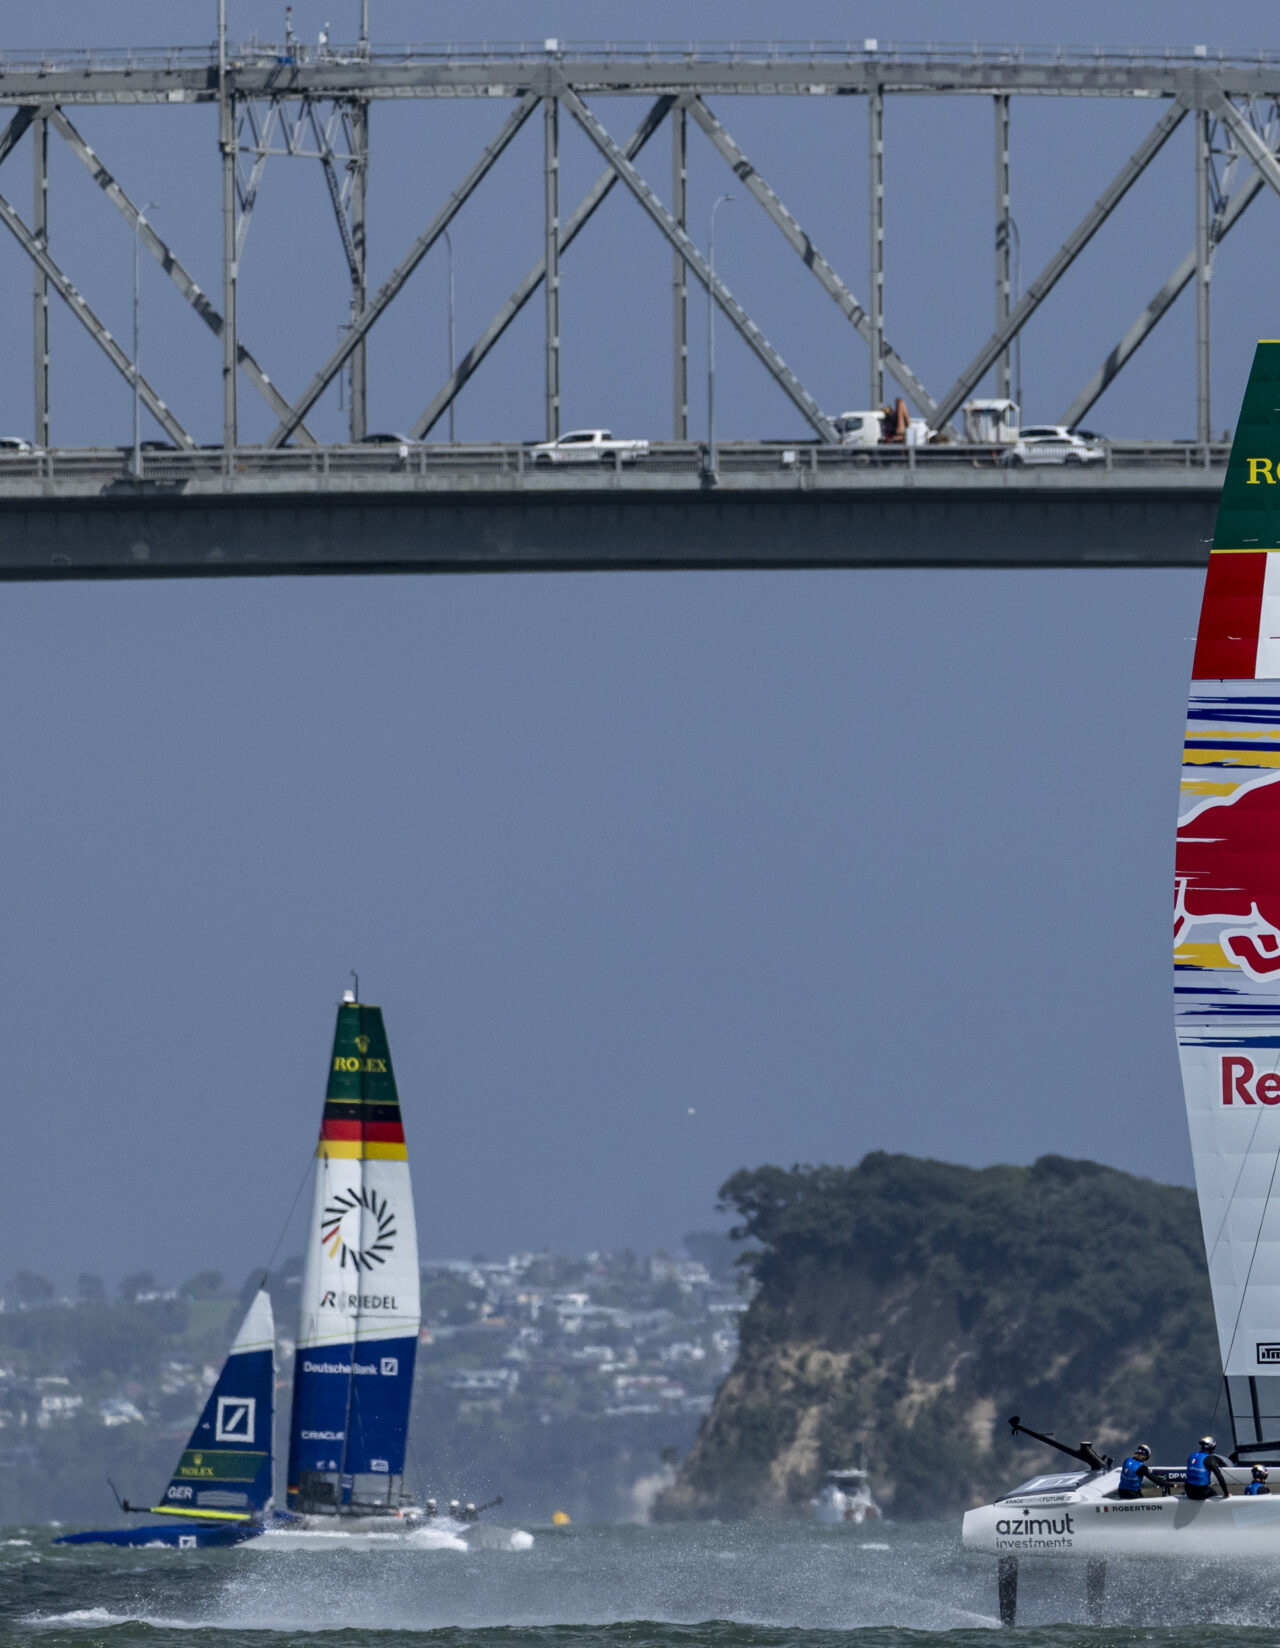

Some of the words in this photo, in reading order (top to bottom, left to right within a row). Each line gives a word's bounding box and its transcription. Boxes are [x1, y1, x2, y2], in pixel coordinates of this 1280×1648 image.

[333, 1056, 387, 1072] ROLEX
[348, 1294, 399, 1309] RIEDEL
[303, 1361, 352, 1374] Deutsche
[352, 1362, 378, 1375] Bank
[301, 1431, 345, 1440] ORACLE
[168, 1485, 194, 1499] GER
[1111, 1504, 1163, 1512] ROBERTSON
[995, 1512, 1075, 1535] azimut
[995, 1536, 1073, 1549] investments
